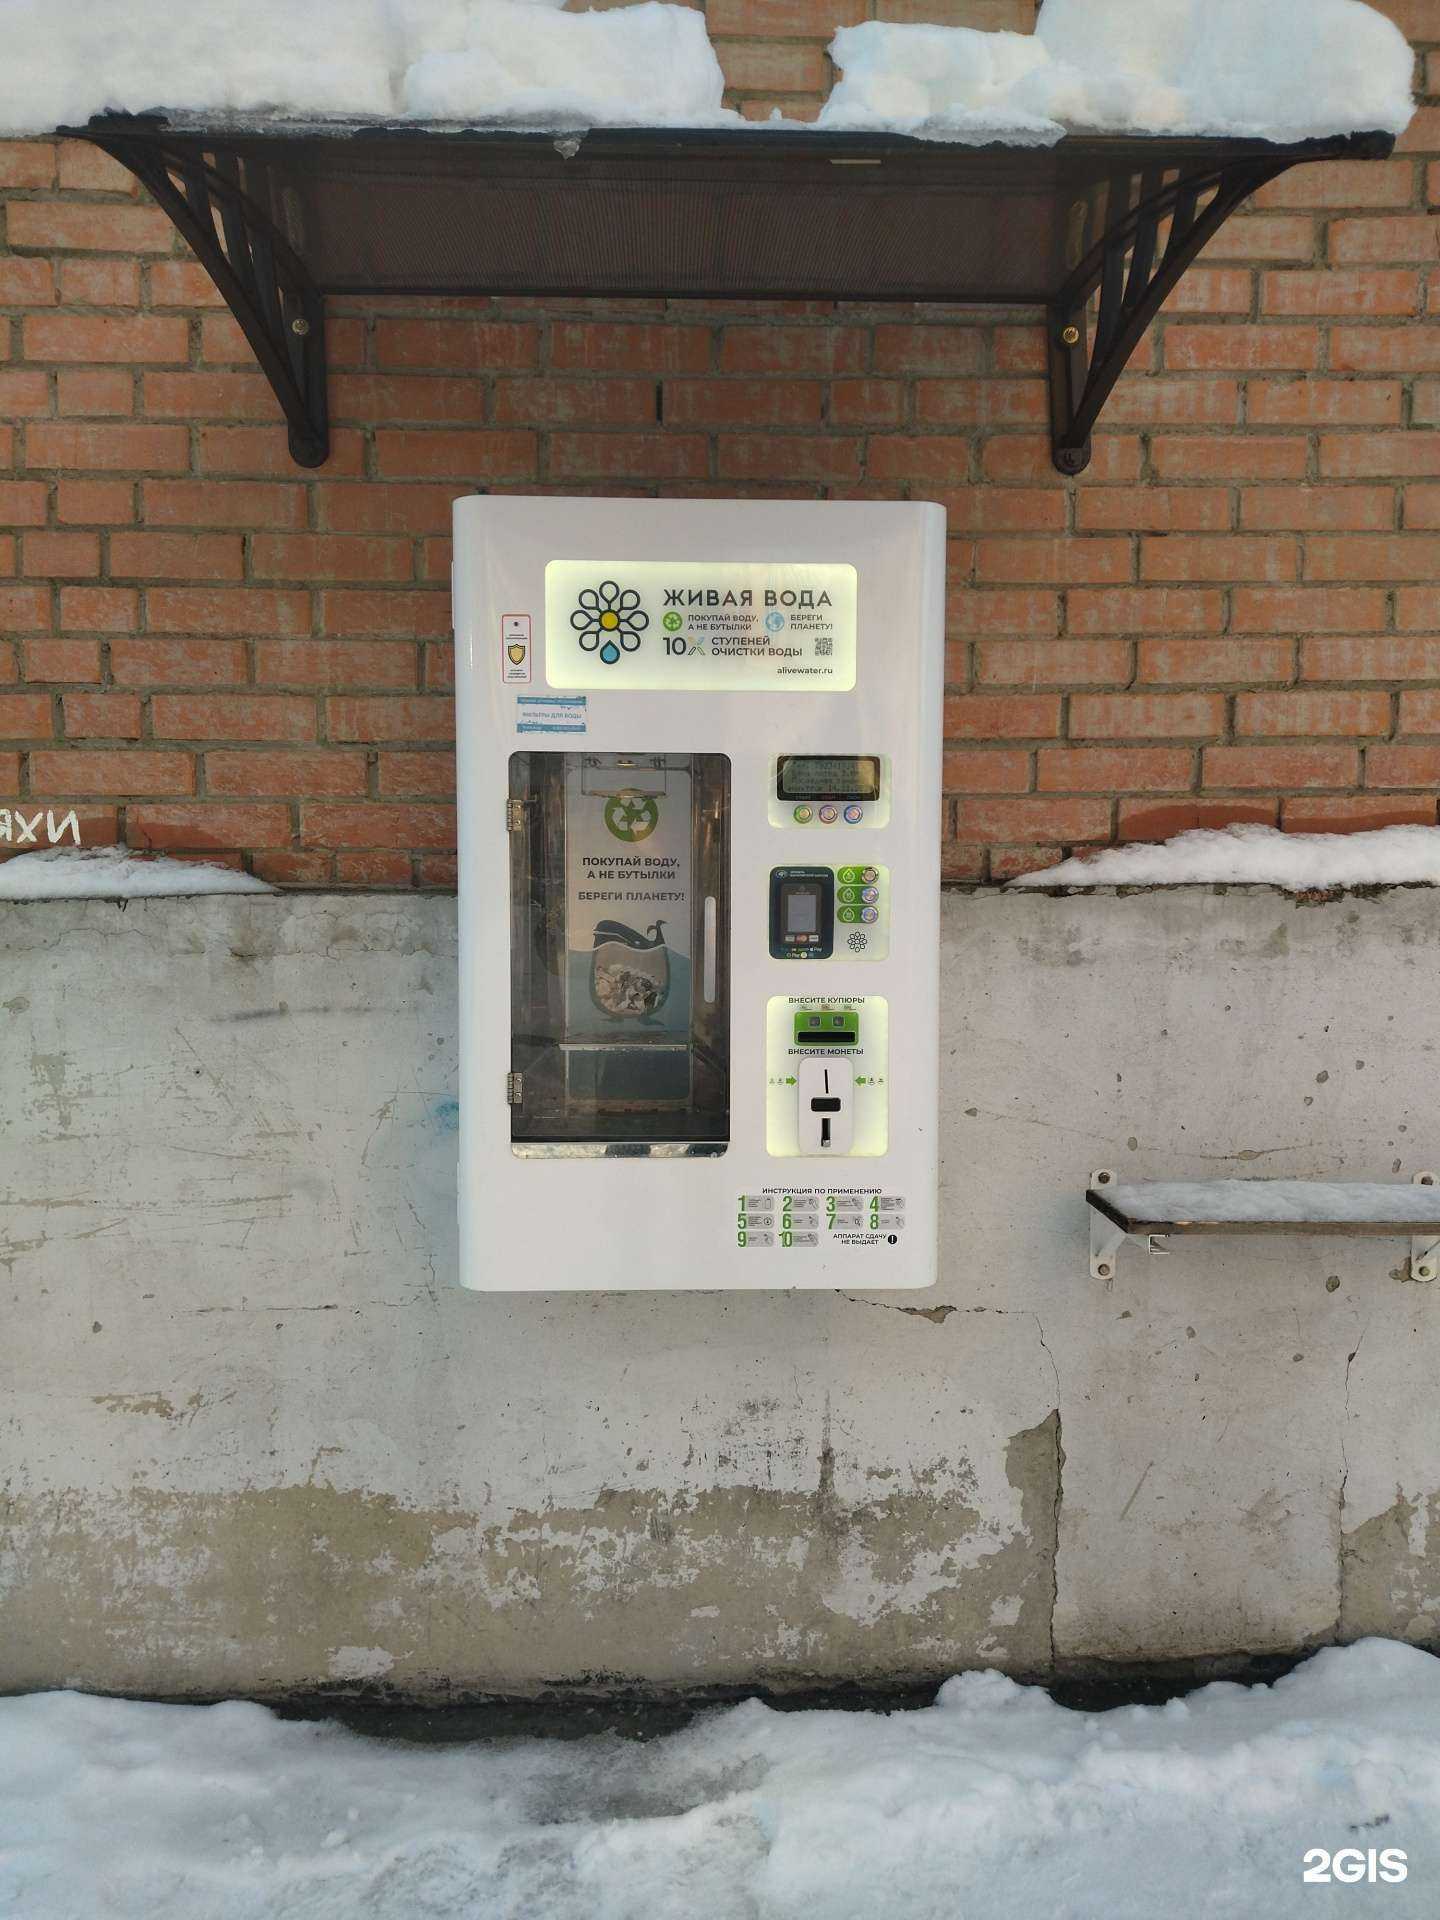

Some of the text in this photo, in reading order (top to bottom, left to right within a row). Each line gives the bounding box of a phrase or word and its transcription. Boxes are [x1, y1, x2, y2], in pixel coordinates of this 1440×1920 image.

[663, 588, 833, 610] ЖИВАЯ ВОДА
[688, 613, 731, 621] ПОКУПАЙ
[688, 623, 752, 631] А НЕ БУТЫЛКИ
[711, 635, 771, 646] СТУПЕНЕЙ
[711, 647, 803, 658] ОЧИСТКИ ВОДЫ
[777, 666, 833, 674] alivewater.ru
[582, 855, 680, 867] ПОКУПАЙ ВОДУ,
[587, 870, 676, 879] А НЕ БУТЫЛКИ
[578, 891, 685, 901] БЕРЕГИ ПЛАНЕТУ!
[827, 996, 865, 1004] КУПЮРЫ
[762, 1187, 813, 1195] ИНСТРУКЦИЯ
[738, 1195, 746, 1211] 1
[783, 1196, 792, 1212] 2
[826, 1196, 836, 1212] 3
[870, 1196, 879, 1212] 4
[738, 1213, 747, 1229] 5
[783, 1213, 792, 1230] 6
[826, 1213, 837, 1230] 7
[870, 1214, 879, 1230] 8
[738, 1231, 747, 1247] 9
[778, 1231, 793, 1247] 10
